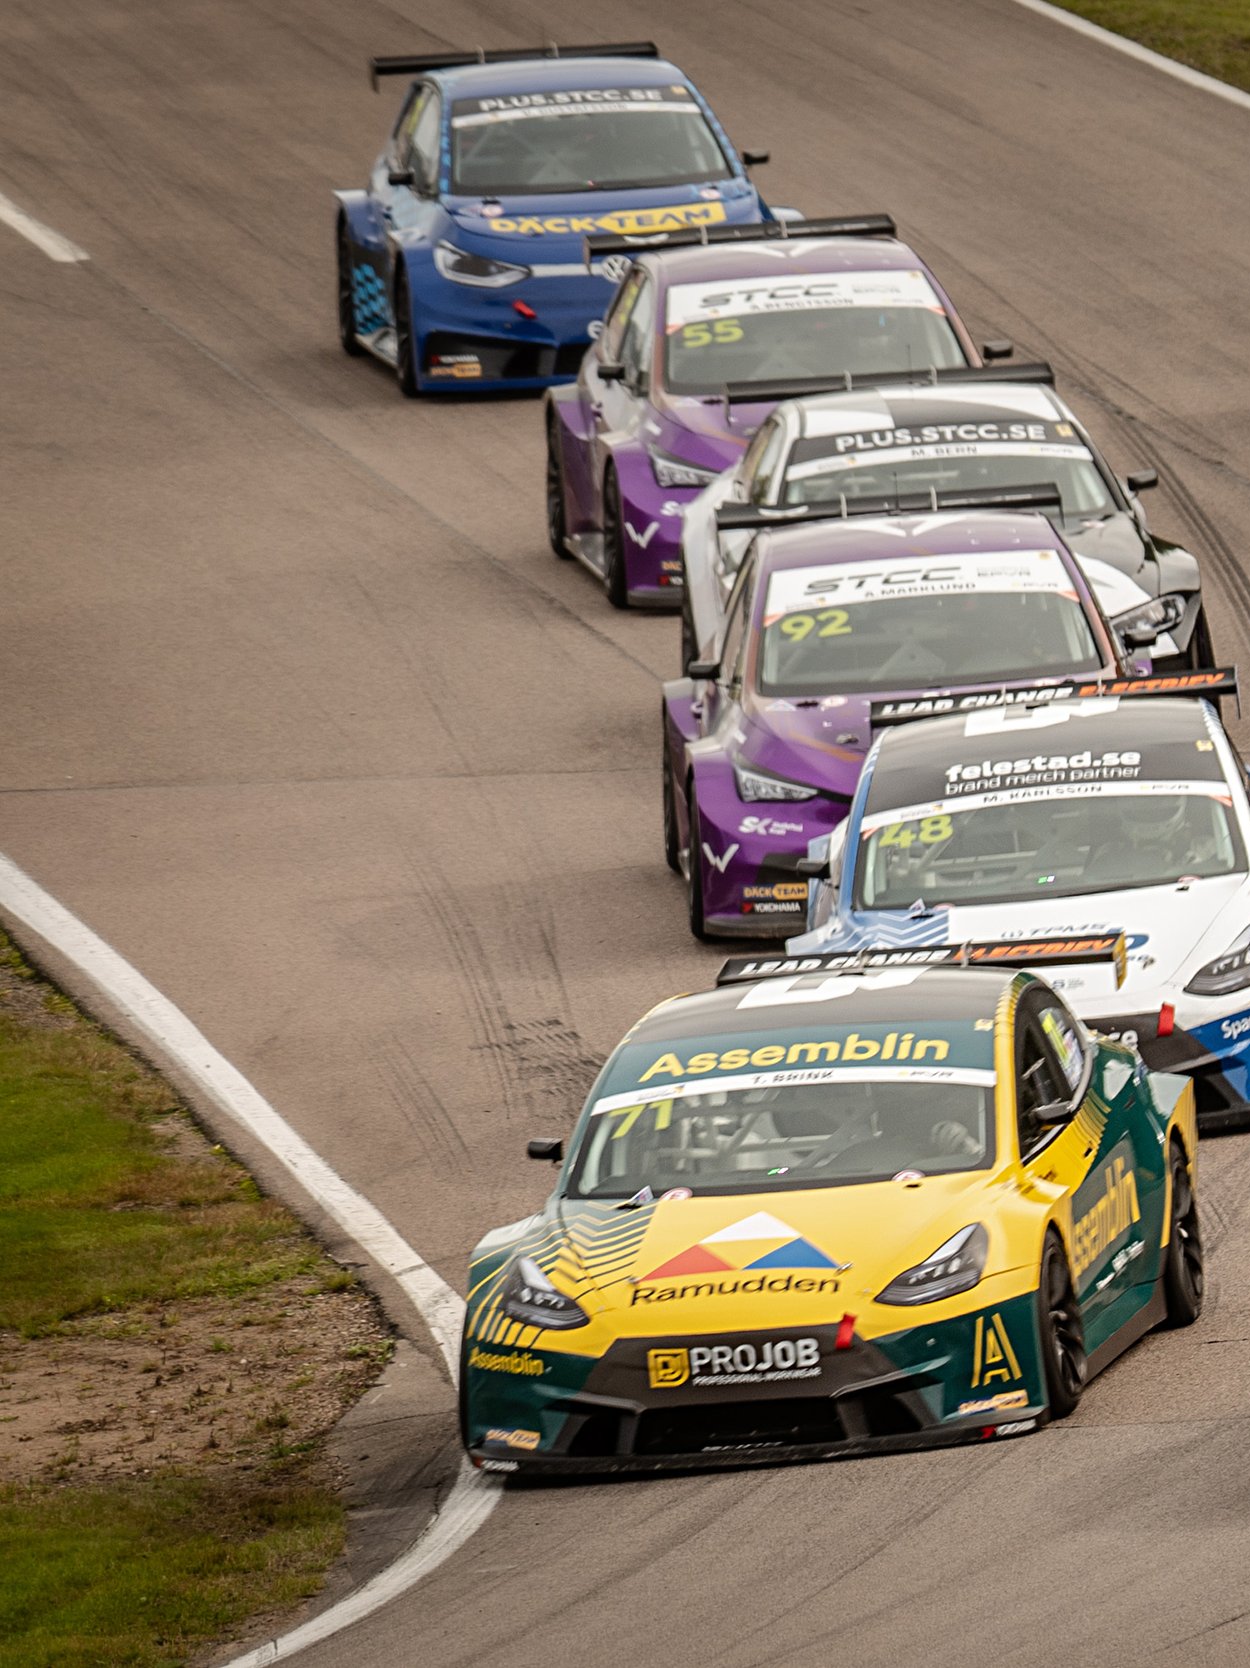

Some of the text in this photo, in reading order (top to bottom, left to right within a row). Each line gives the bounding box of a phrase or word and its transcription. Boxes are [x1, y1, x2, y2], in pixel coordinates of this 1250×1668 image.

[478, 88, 663, 112] PLUS.STCC.SE
[699, 283, 839, 308] STCC
[682, 318, 744, 348] 55
[835, 423, 1046, 451] PLUS.STCC.SE
[804, 566, 962, 596] STCC
[780, 609, 852, 642] 92
[882, 699, 954, 716] LEAD
[959, 687, 1074, 709] CHANGE
[945, 766, 1142, 796] brand merch partner
[879, 815, 953, 848] 48
[754, 902, 801, 913] YOKOHAMA
[738, 959, 823, 976] LEAD
[638, 1032, 951, 1084] Assemblin
[608, 1098, 676, 1141] 71
[629, 1273, 842, 1307] Ramudden
[690, 1338, 821, 1376] PROJOB
